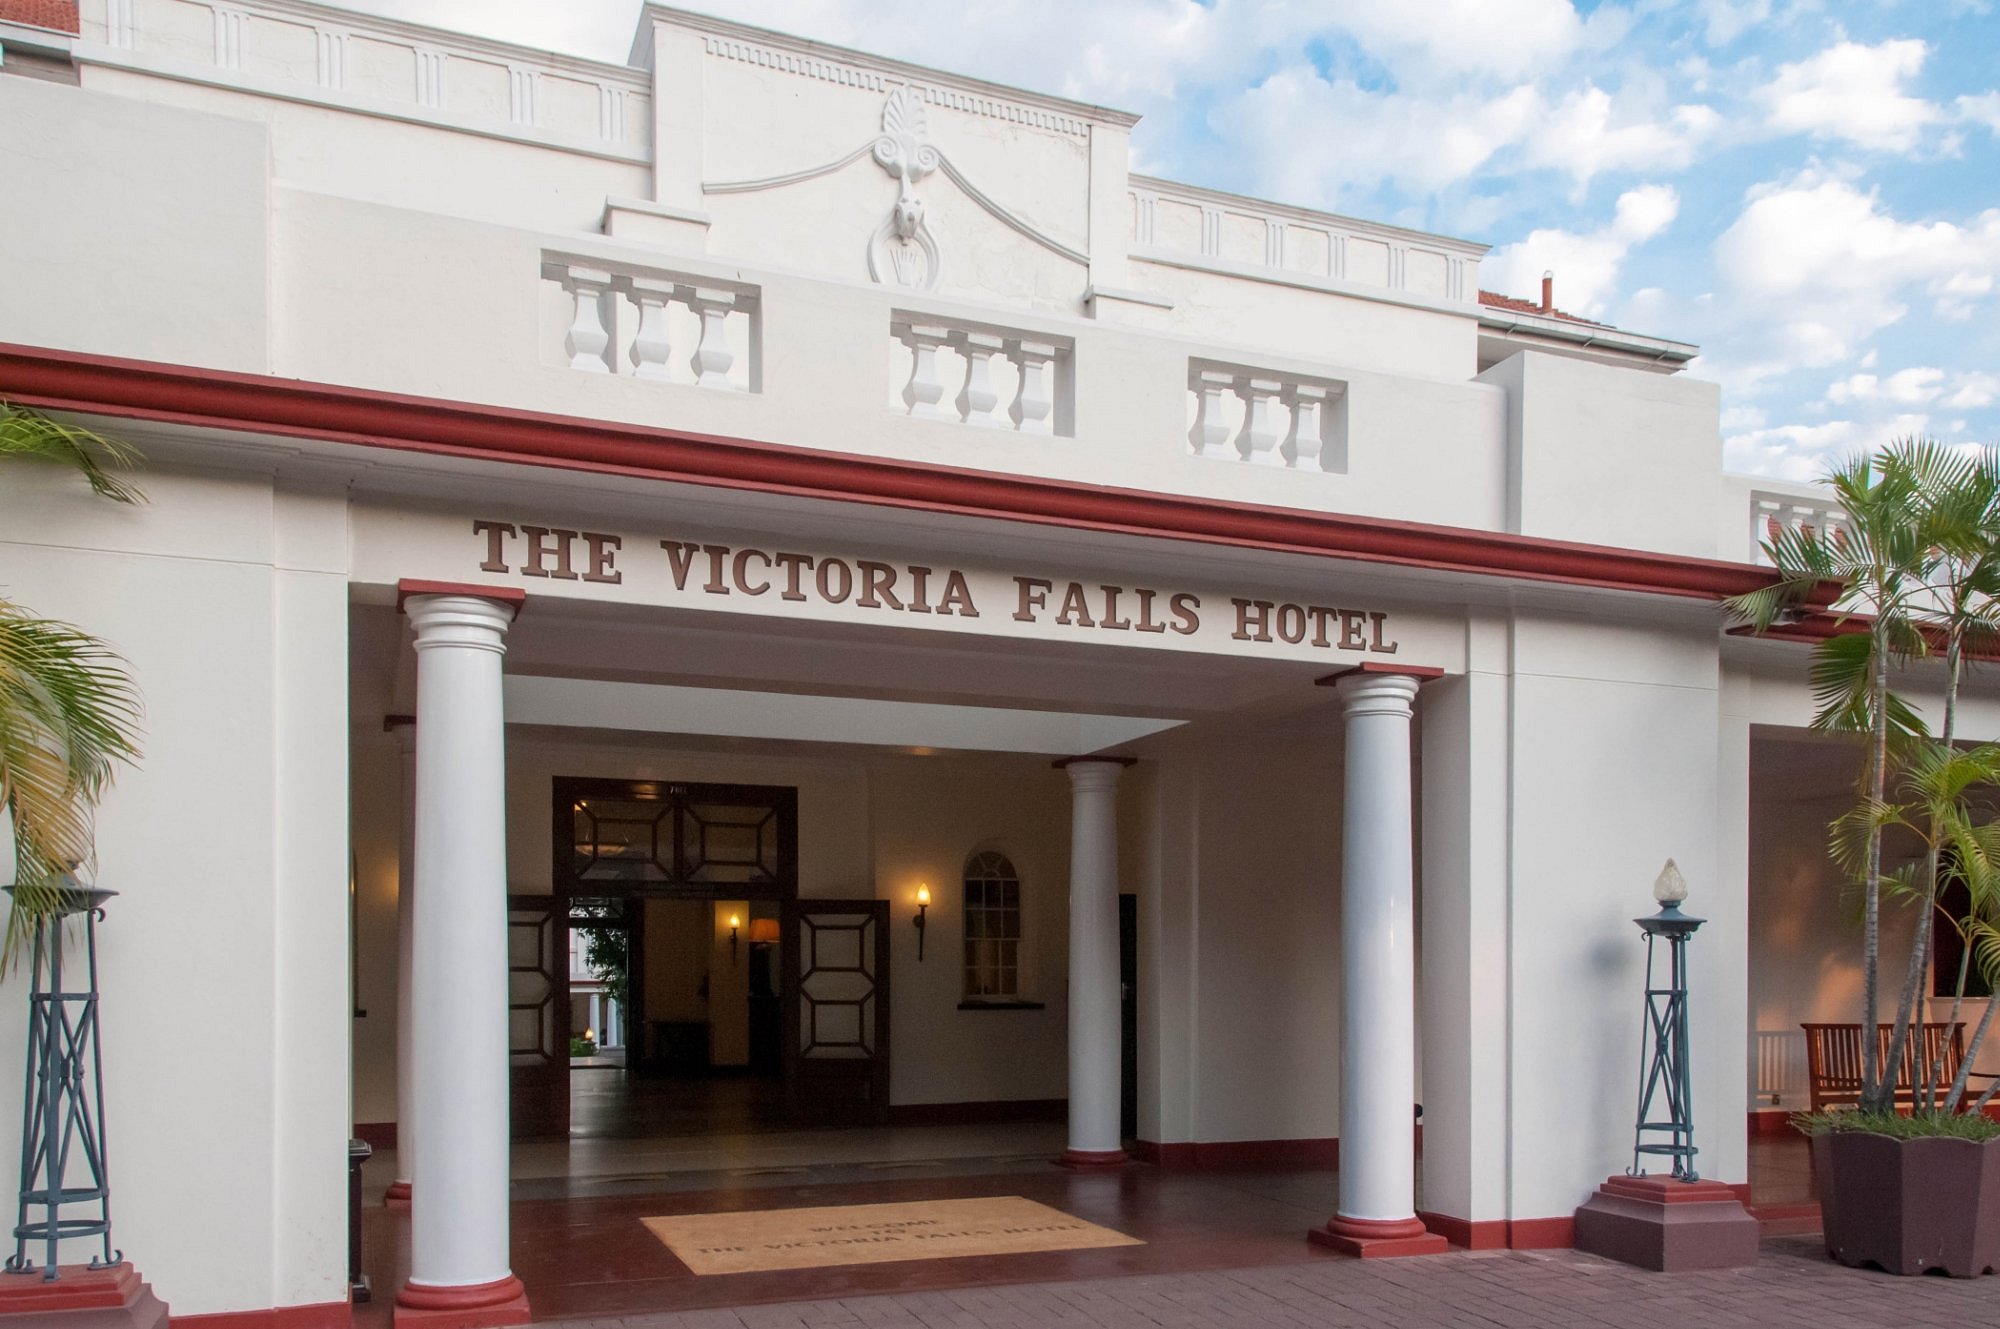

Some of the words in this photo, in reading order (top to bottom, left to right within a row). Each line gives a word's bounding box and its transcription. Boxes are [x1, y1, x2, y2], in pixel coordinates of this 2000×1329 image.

[473, 520, 622, 584] THE
[660, 540, 979, 617] VICTORIA
[1012, 576, 1201, 635] FALLS
[1231, 598, 1398, 654] HOTEL
[764, 1236, 903, 1249] VICTORIA
[914, 1230, 992, 1239] FALLS
[1003, 1224, 1086, 1234] HOTEL
[810, 1220, 937, 1232] WELCOME
